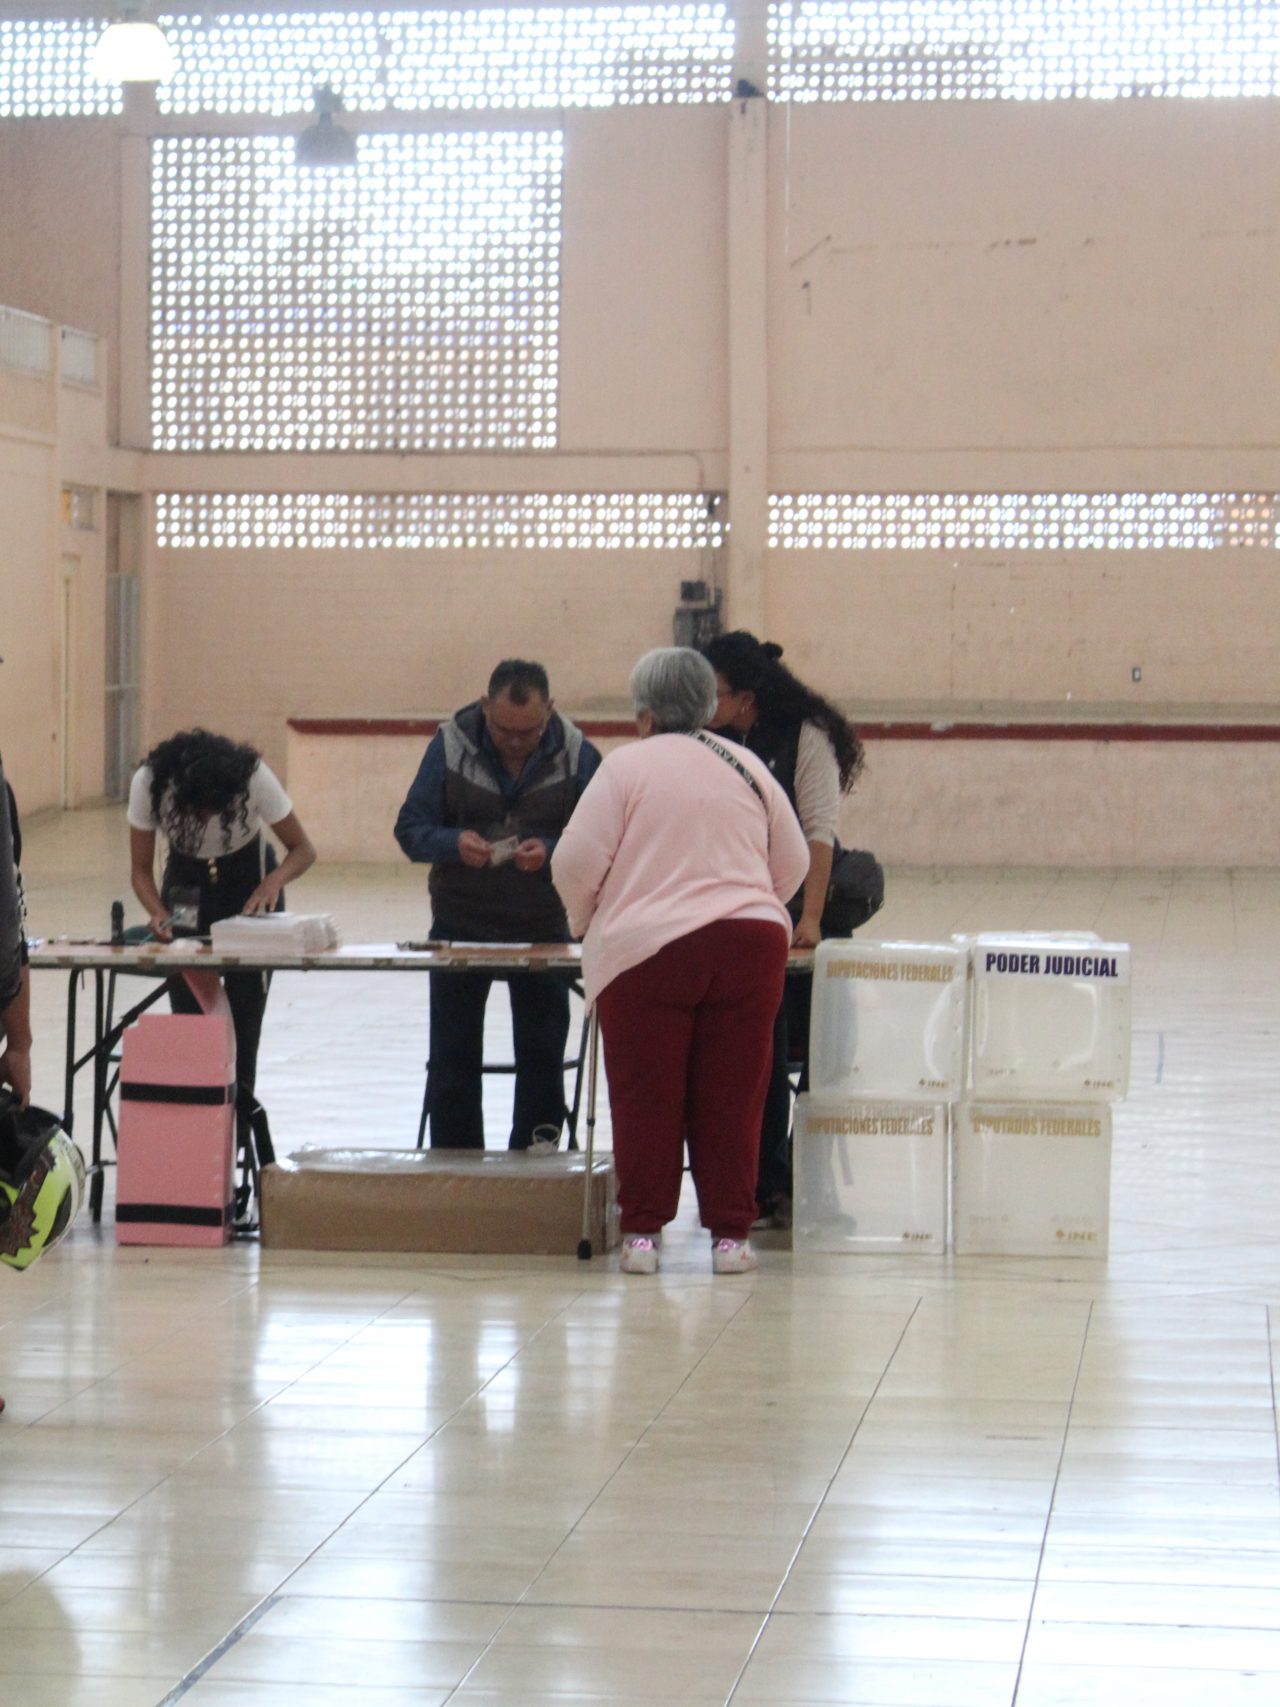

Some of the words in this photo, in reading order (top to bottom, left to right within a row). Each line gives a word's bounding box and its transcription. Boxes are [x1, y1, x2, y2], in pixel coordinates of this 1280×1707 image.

[826, 959, 898, 980] DIPUTACIONES
[901, 963, 954, 982] FEDERALES
[986, 952, 1040, 974] PODER
[1043, 955, 1118, 977] JUDICIAL
[807, 1116, 878, 1135] DIPUTACIONES
[1040, 1117, 1102, 1137] FEDERALES
